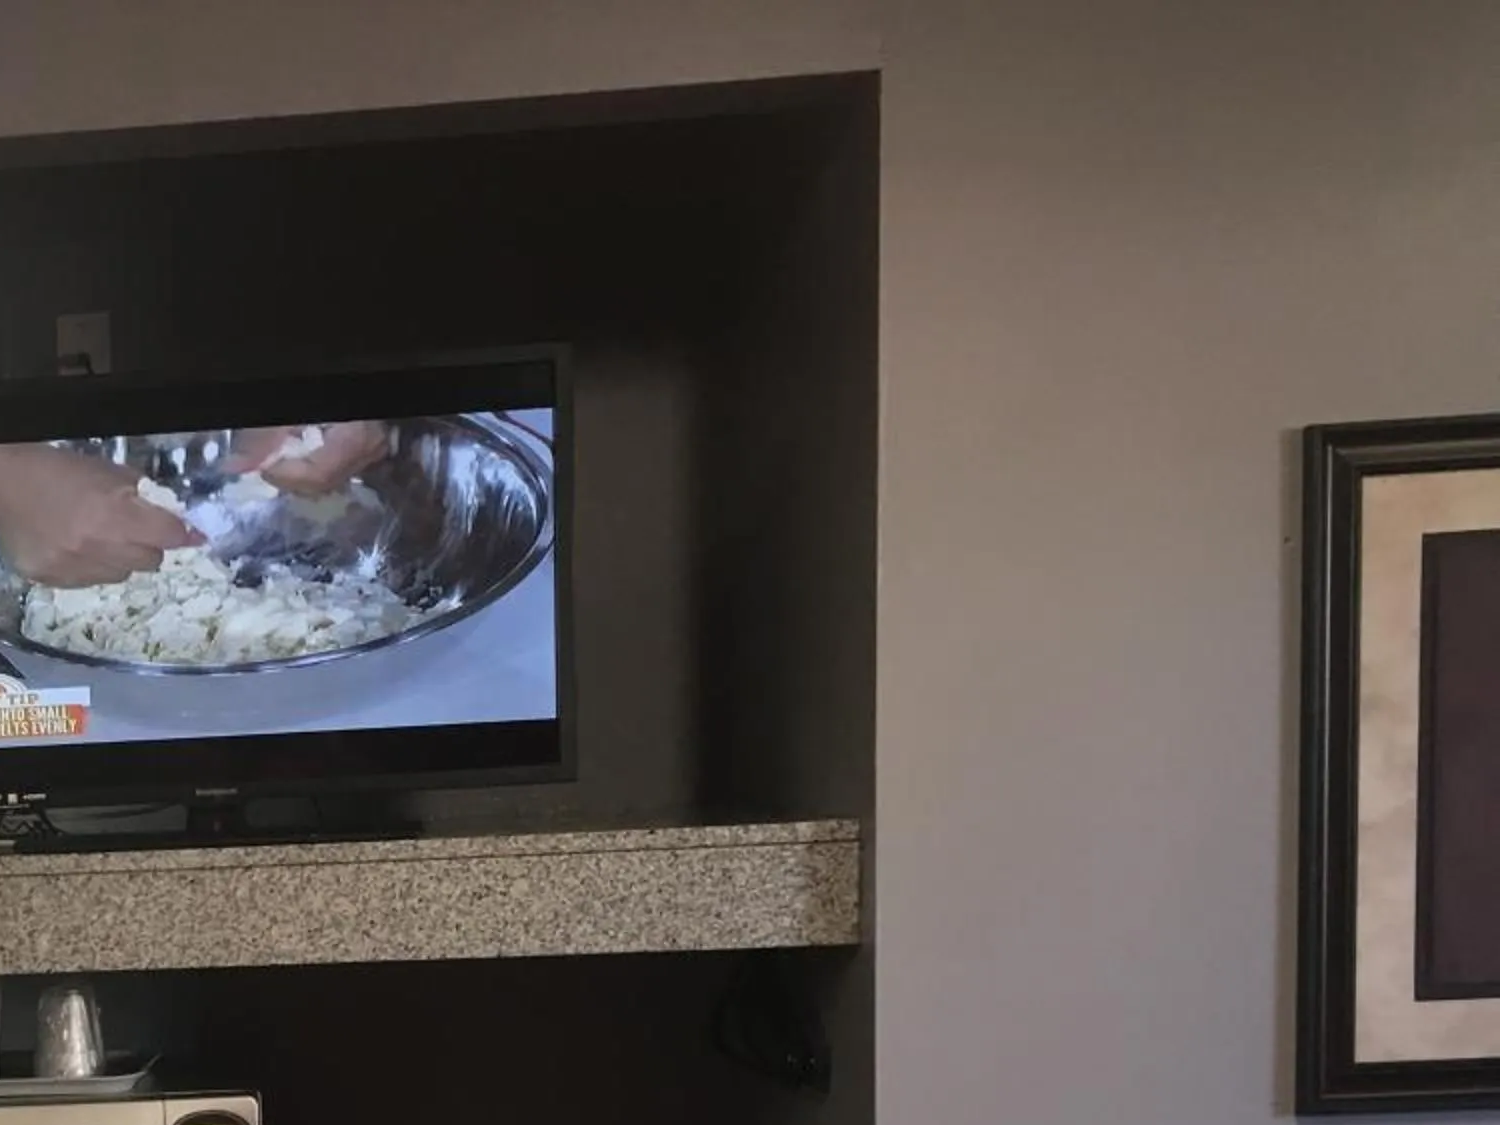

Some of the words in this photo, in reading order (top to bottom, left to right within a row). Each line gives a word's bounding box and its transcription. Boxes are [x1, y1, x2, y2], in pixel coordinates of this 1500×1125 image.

[6, 693, 40, 706] TIP
[27, 705, 68, 720] SMALL
[32, 719, 77, 735] EVENLY
